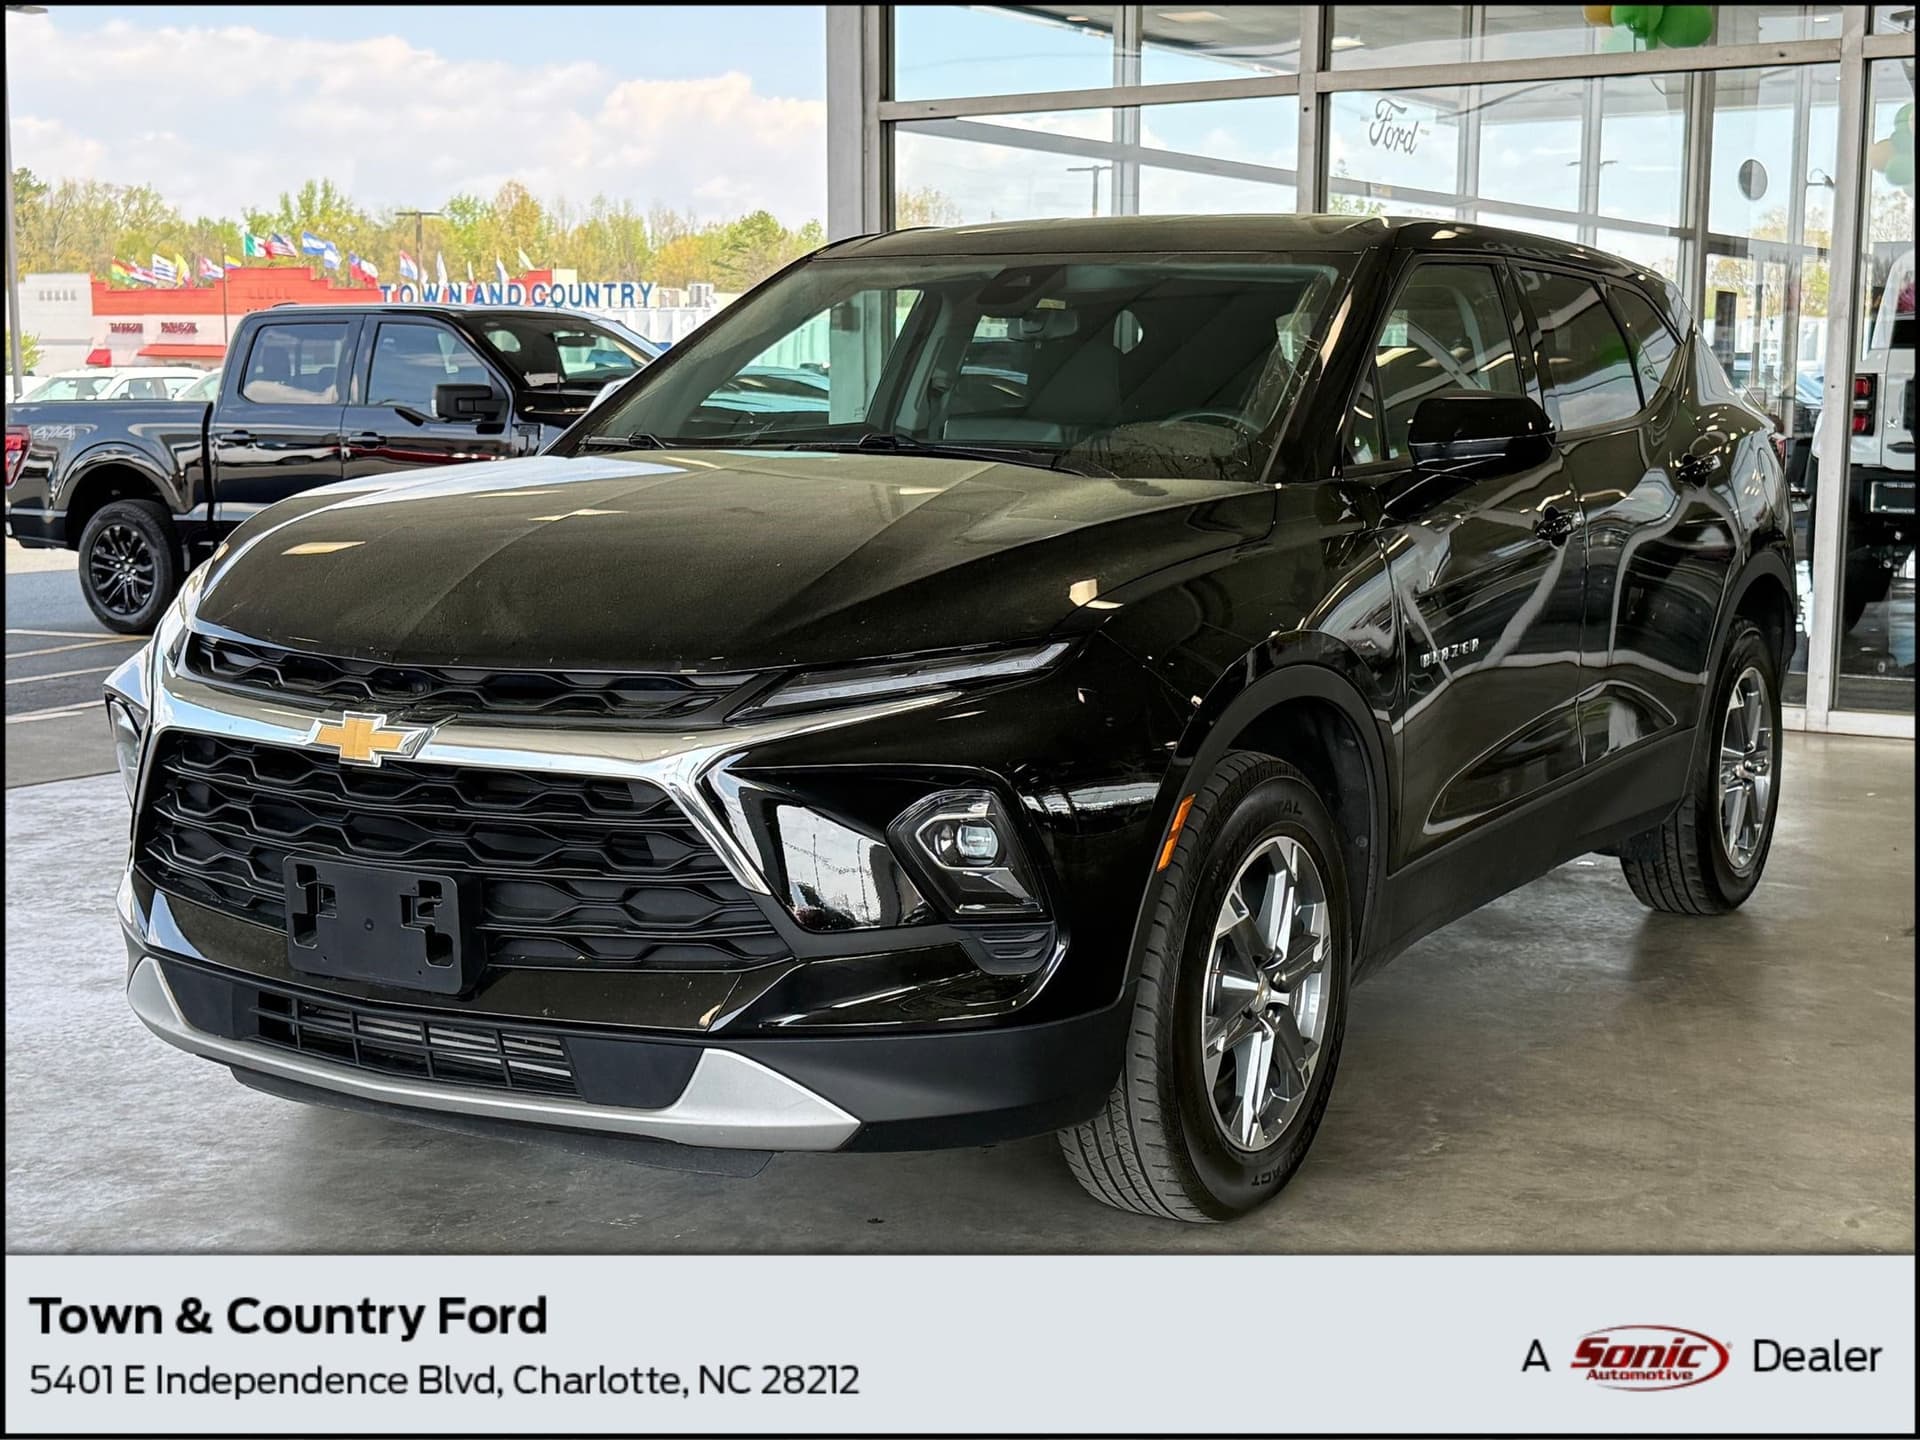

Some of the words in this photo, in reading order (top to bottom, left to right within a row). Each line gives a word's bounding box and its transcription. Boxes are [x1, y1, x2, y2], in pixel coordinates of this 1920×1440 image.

[1368, 98, 1419, 155] Ford
[379, 283, 463, 303] TOWN
[473, 283, 523, 305] AND
[531, 283, 653, 308] COUNTRY
[1420, 638, 1480, 668] BLAZER
